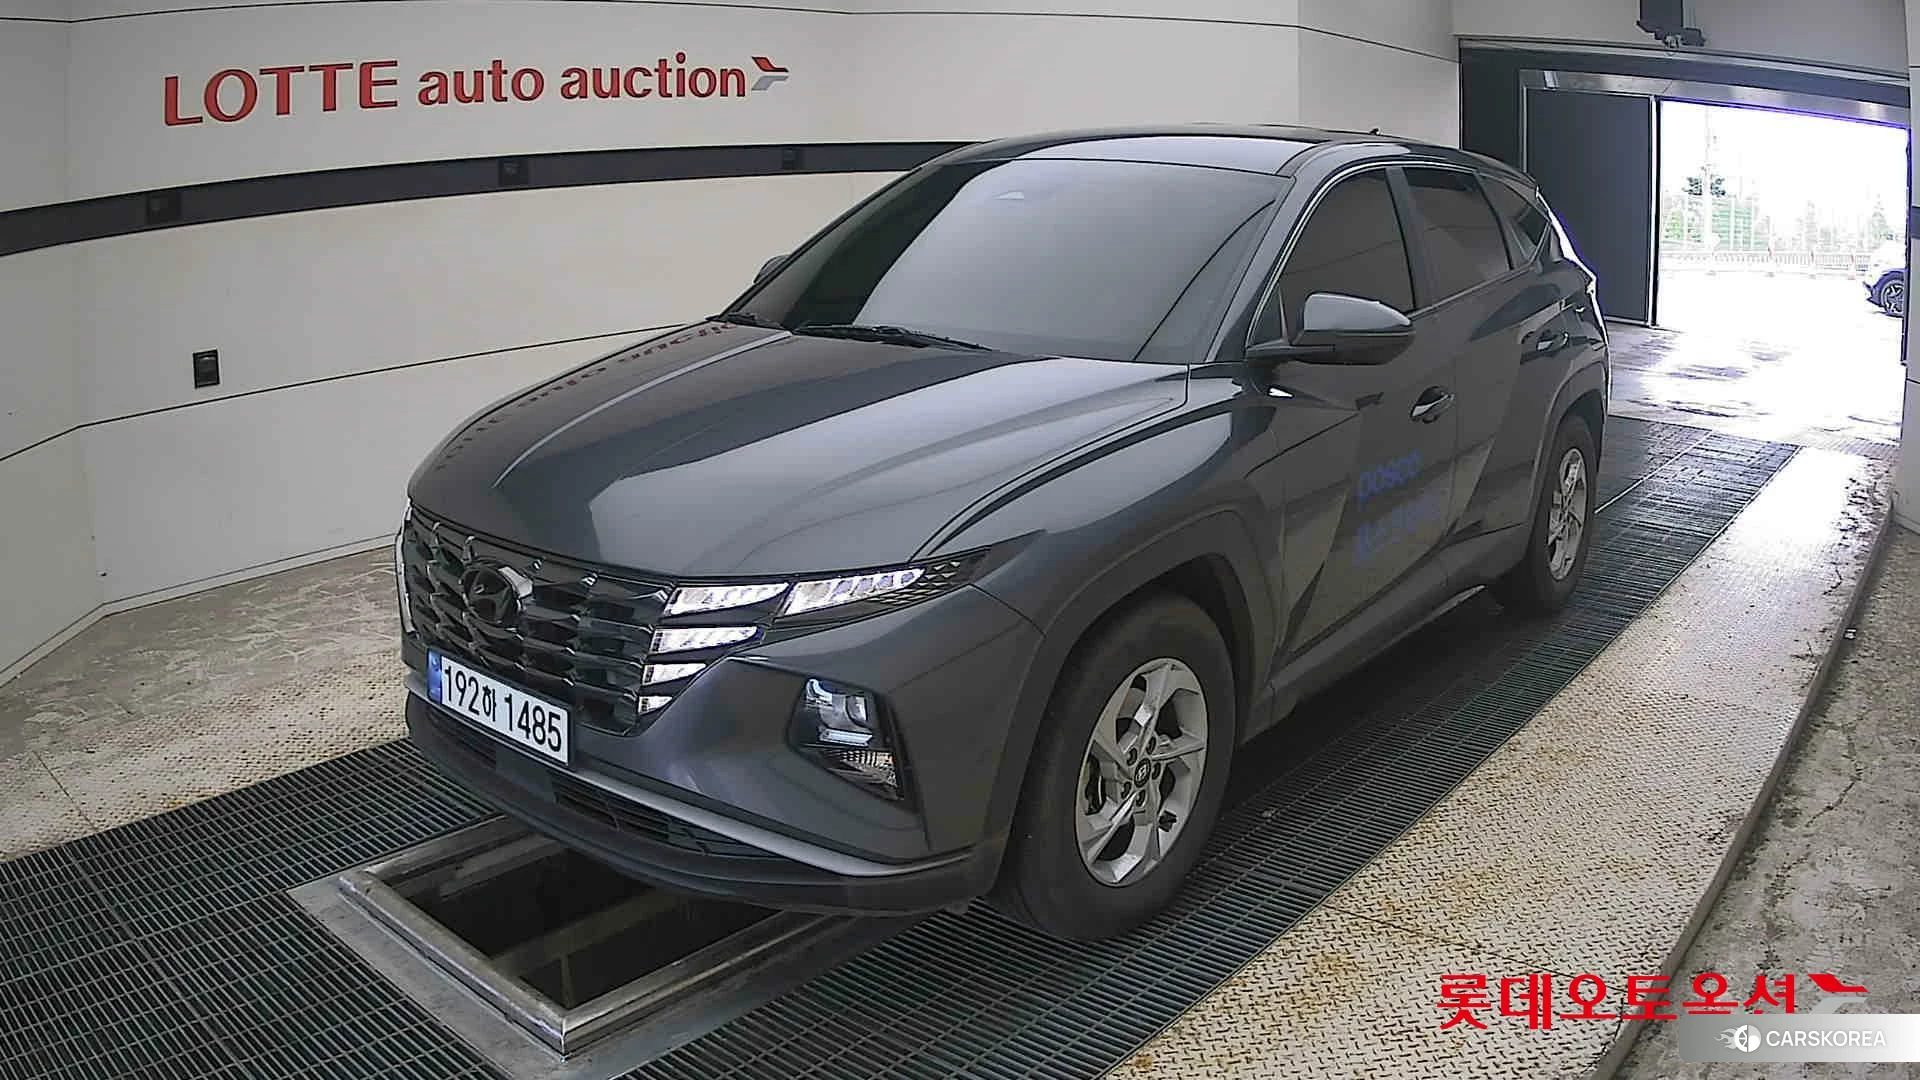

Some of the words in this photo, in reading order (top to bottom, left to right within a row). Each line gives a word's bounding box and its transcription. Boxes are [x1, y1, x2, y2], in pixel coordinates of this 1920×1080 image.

[164, 60, 399, 126] LOTTE
[417, 59, 545, 106] auto
[560, 52, 747, 99] auction
[444, 665, 496, 722] 192하
[504, 692, 562, 752] 1485
